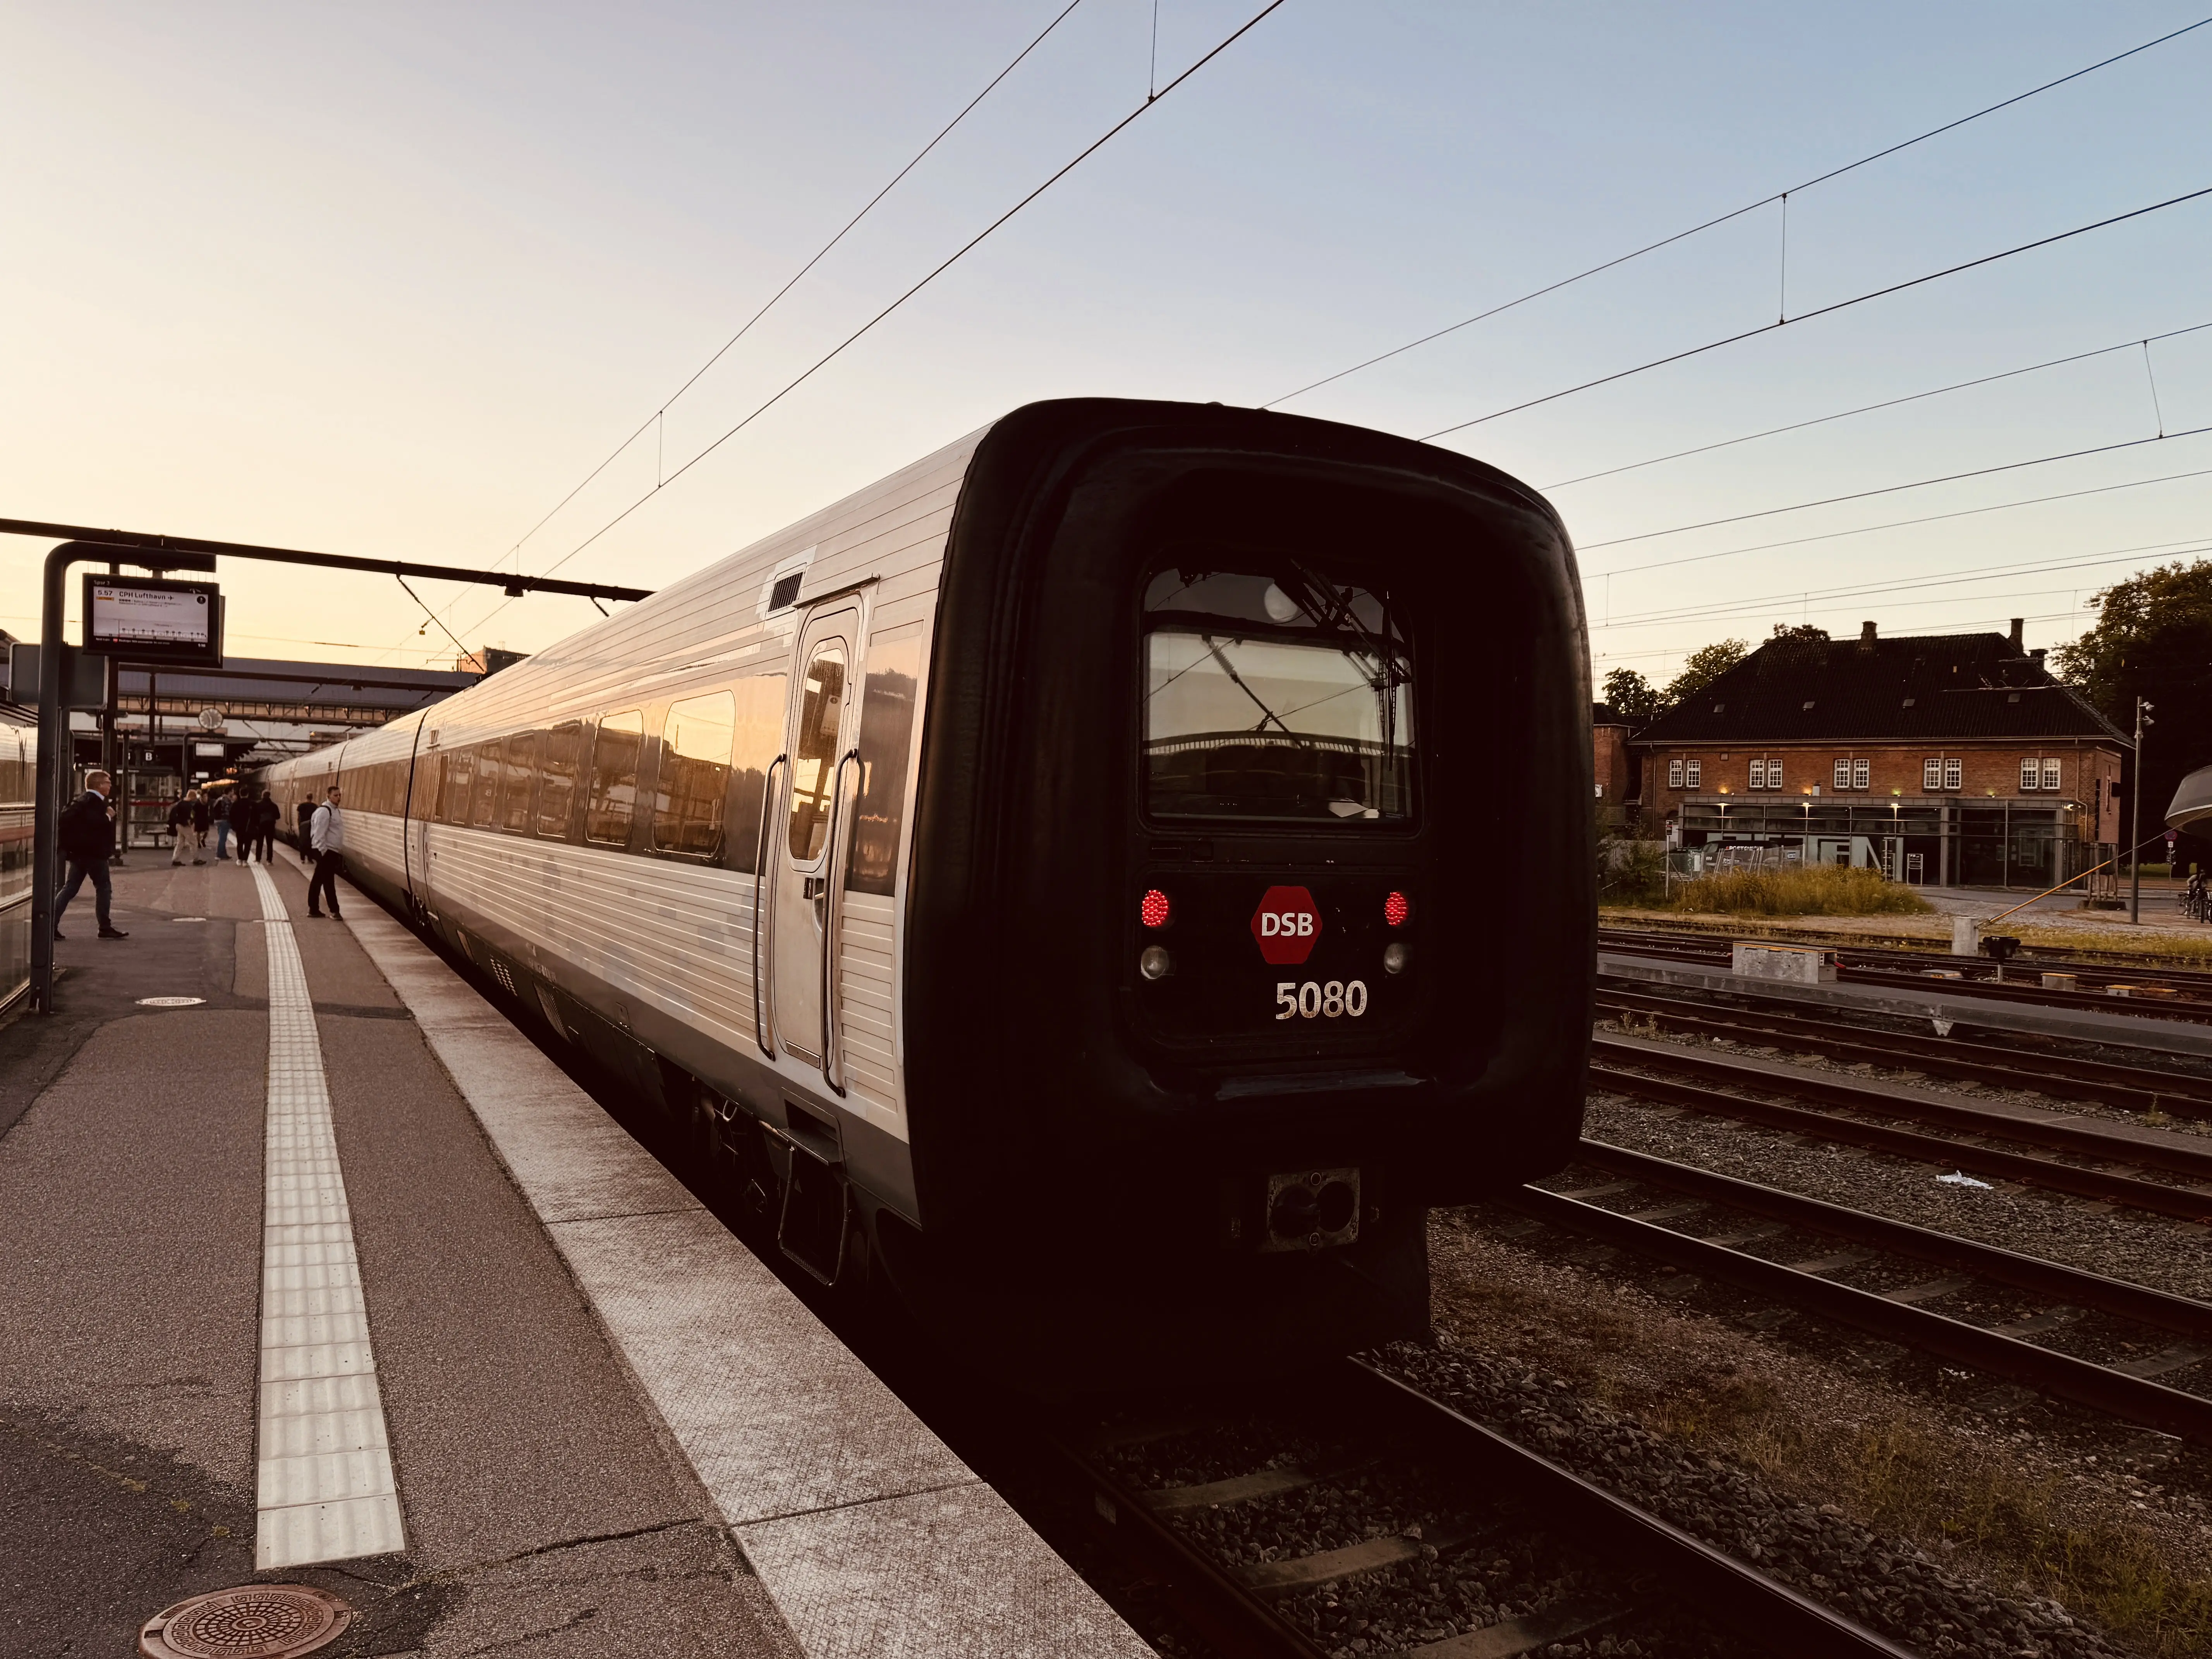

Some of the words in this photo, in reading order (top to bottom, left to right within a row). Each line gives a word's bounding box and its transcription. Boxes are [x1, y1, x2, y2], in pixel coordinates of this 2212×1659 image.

[135, 592, 166, 600] Lufthavn
[145, 752, 153, 761] B
[1261, 912, 1313, 936] DSB
[1276, 980, 1367, 1020] 5080
